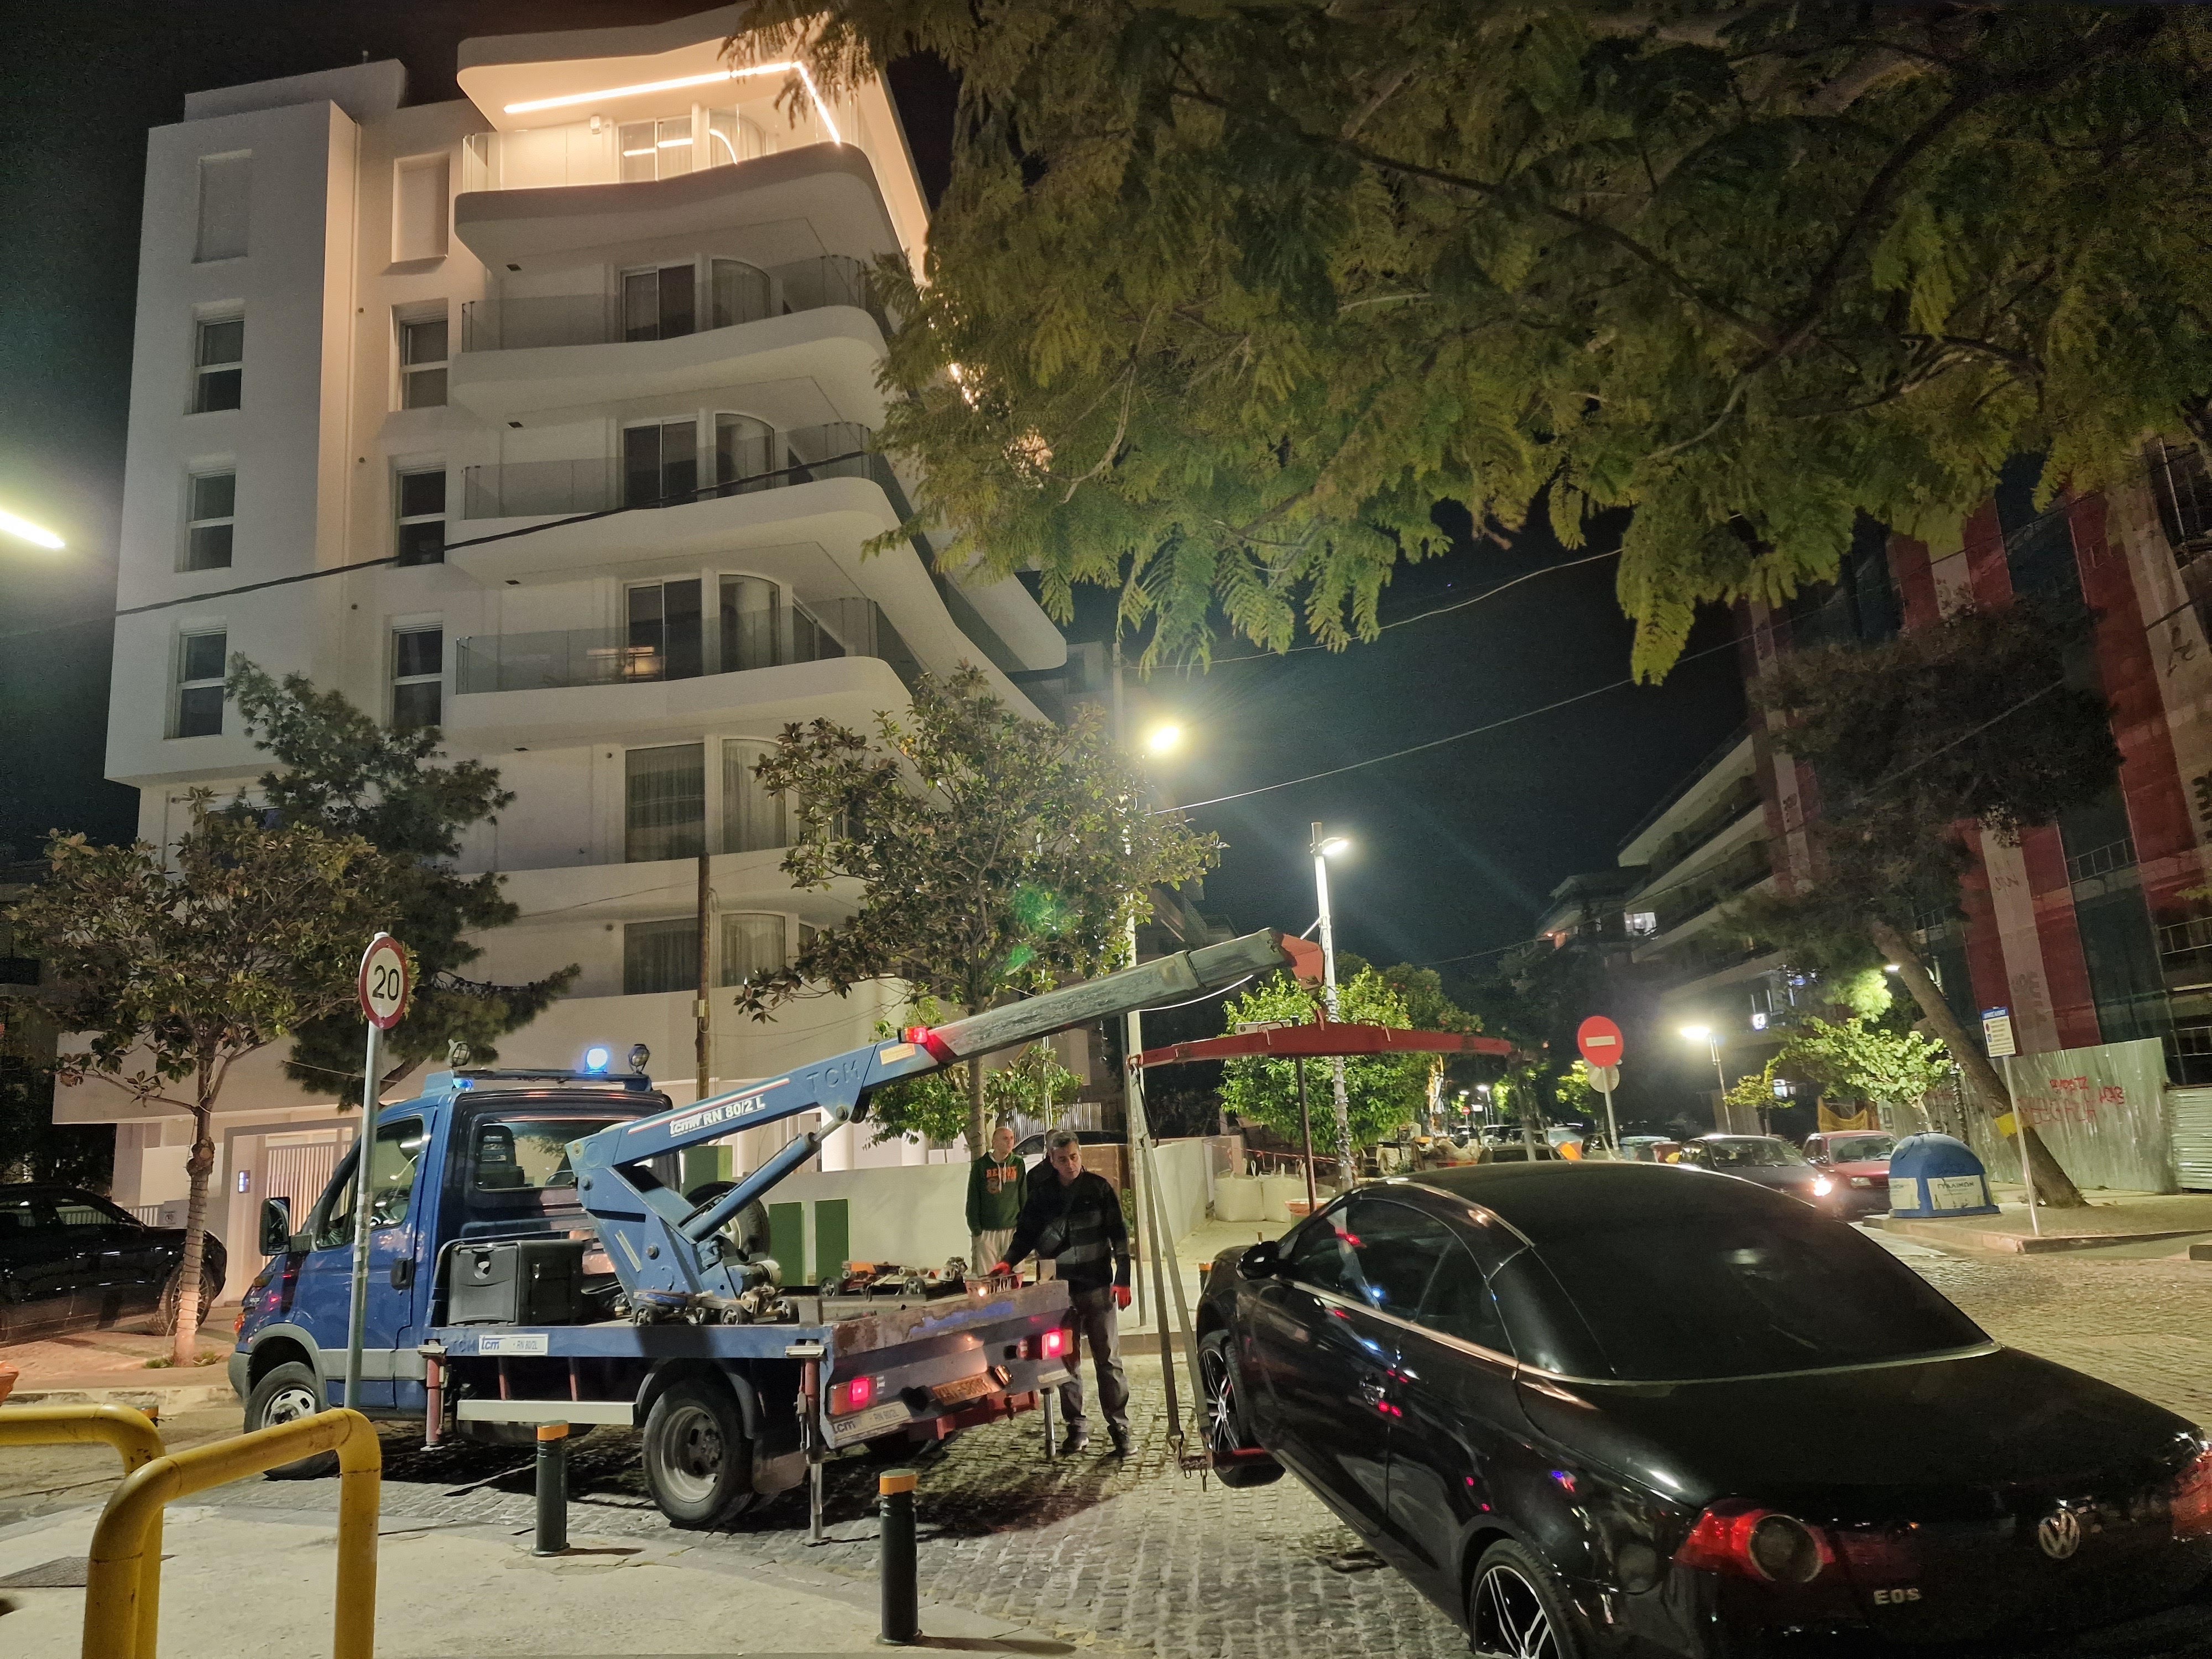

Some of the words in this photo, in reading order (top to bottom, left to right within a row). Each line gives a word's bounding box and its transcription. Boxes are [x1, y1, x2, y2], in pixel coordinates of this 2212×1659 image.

[372, 965, 399, 1000] 20
[807, 1060, 860, 1093] TCM
[703, 1109, 722, 1125] RN
[726, 1100, 754, 1118] 80/2
[755, 1097, 766, 1109] L
[482, 1337, 505, 1350] tcm
[1874, 1588, 1921, 1605] EOS
